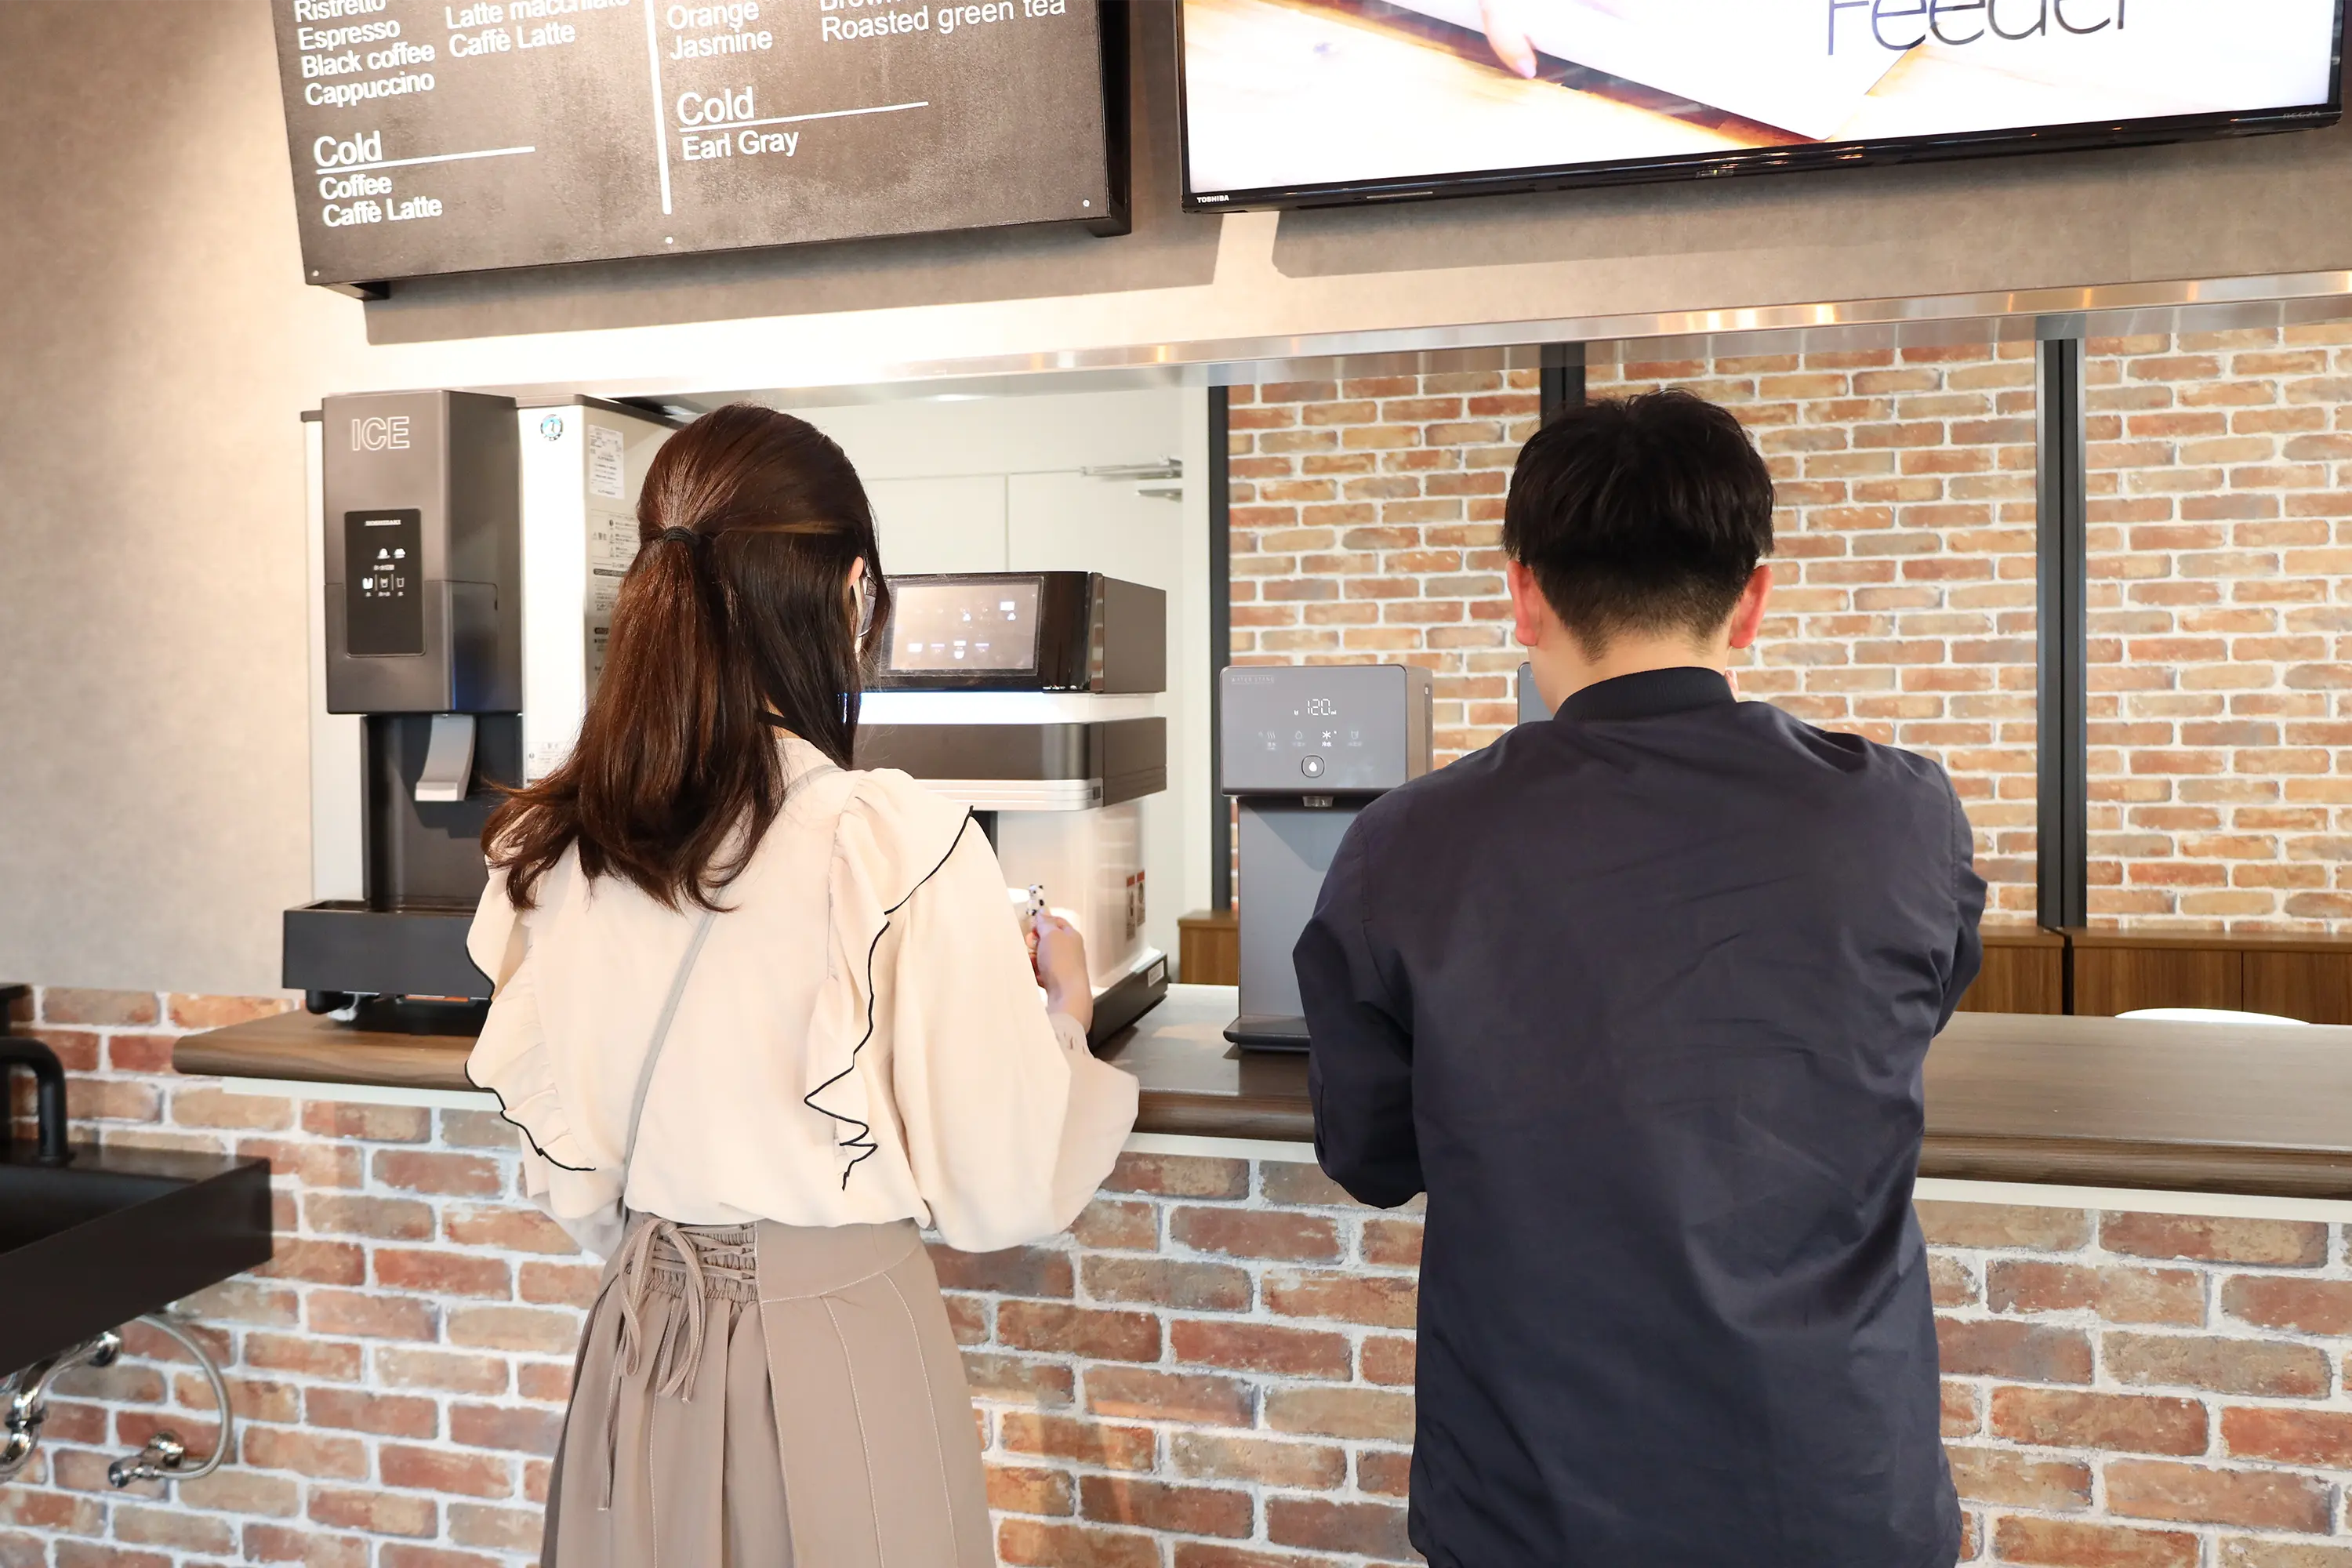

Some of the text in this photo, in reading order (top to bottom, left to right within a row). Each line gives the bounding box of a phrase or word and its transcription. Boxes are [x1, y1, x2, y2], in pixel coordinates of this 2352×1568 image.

[294, 0, 387, 23] Ristretto
[445, 2, 503, 30] Latte
[666, 2, 760, 30] Orange
[821, 0, 1066, 42] Roasted green tea
[297, 20, 401, 51] Espresso
[448, 22, 575, 58] Caffè Latte
[670, 28, 773, 60] Jasmine
[301, 42, 436, 78] Black coffee
[305, 71, 435, 108] Cappuccino
[677, 85, 755, 125] Cold
[314, 130, 383, 167] Cold
[682, 129, 800, 161] Earl Gray
[319, 173, 393, 200] Coffee
[1196, 194, 1229, 203] TOSHIBA
[322, 196, 443, 227] Caffè Latte
[351, 416, 411, 451] ICE
[1307, 698, 1331, 715] 120
